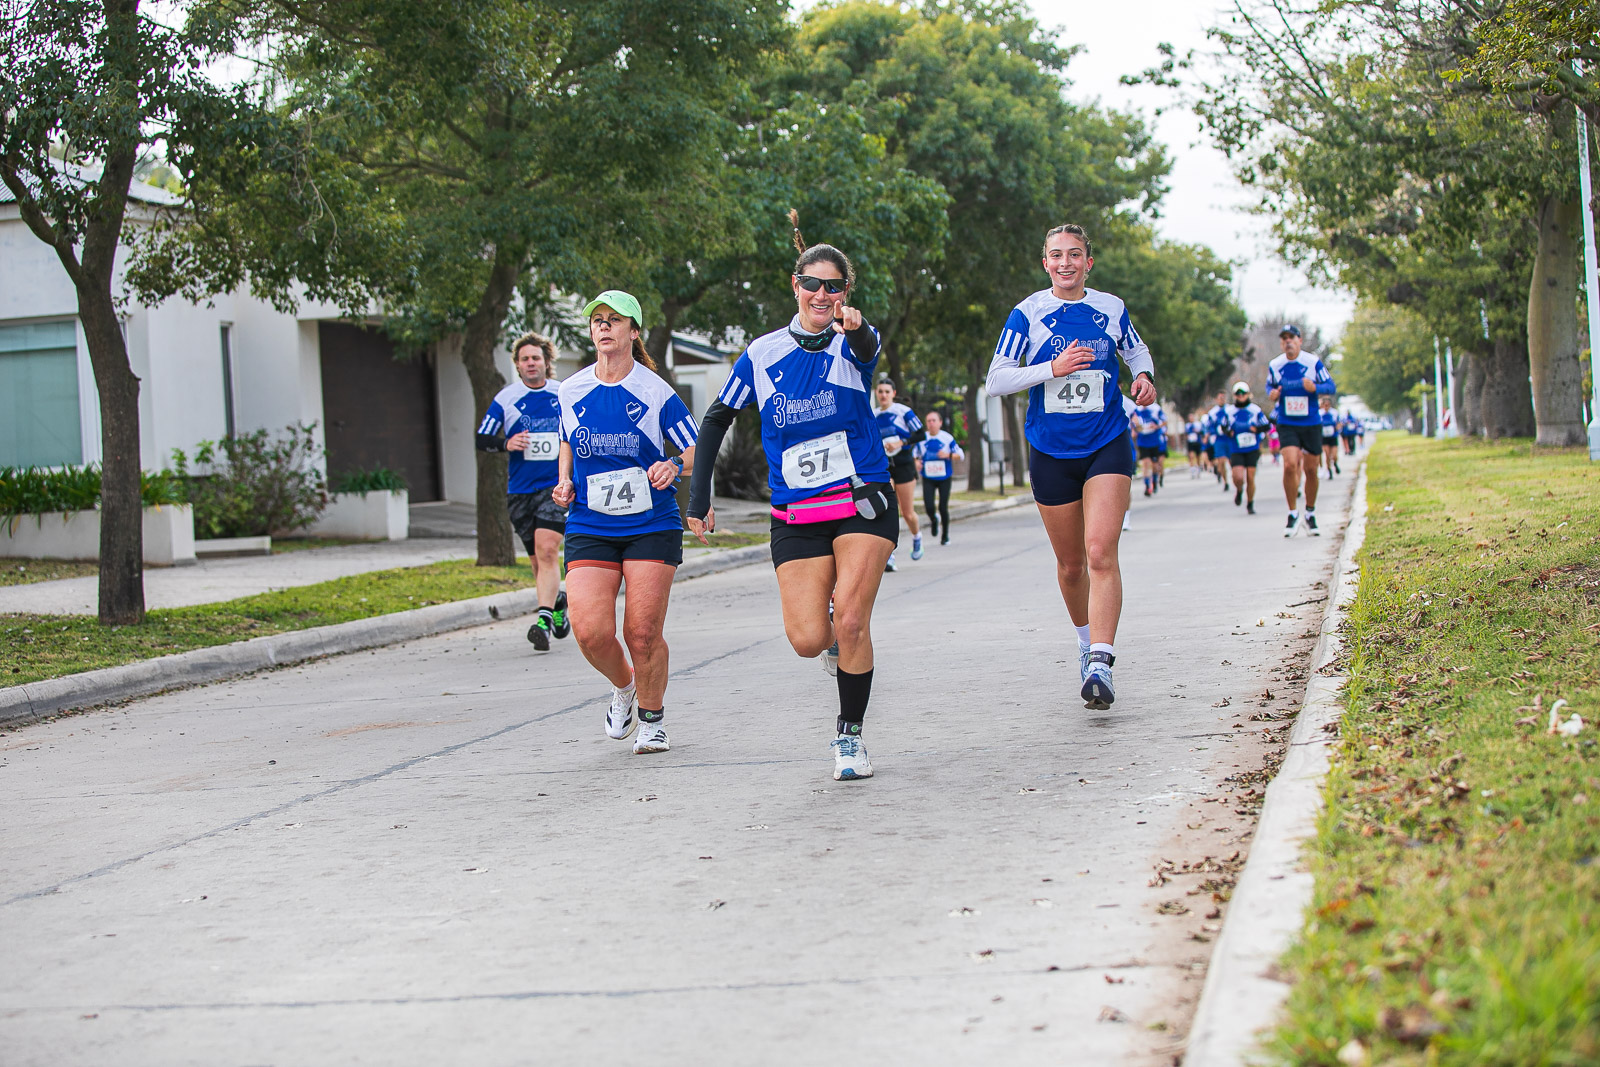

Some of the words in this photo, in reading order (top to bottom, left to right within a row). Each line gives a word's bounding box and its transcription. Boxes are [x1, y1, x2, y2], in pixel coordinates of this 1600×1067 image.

[1051, 335, 1066, 360] 3
[1057, 383, 1090, 403] 49
[773, 392, 787, 428] 3
[787, 390, 835, 415] MARATÓN
[1287, 401, 1305, 411] 526
[520, 414, 532, 431] 3
[531, 441, 552, 454] 30
[576, 426, 591, 458] 3
[591, 432, 640, 448] MARATÓN
[797, 447, 830, 478] 57
[601, 481, 635, 507] 74
